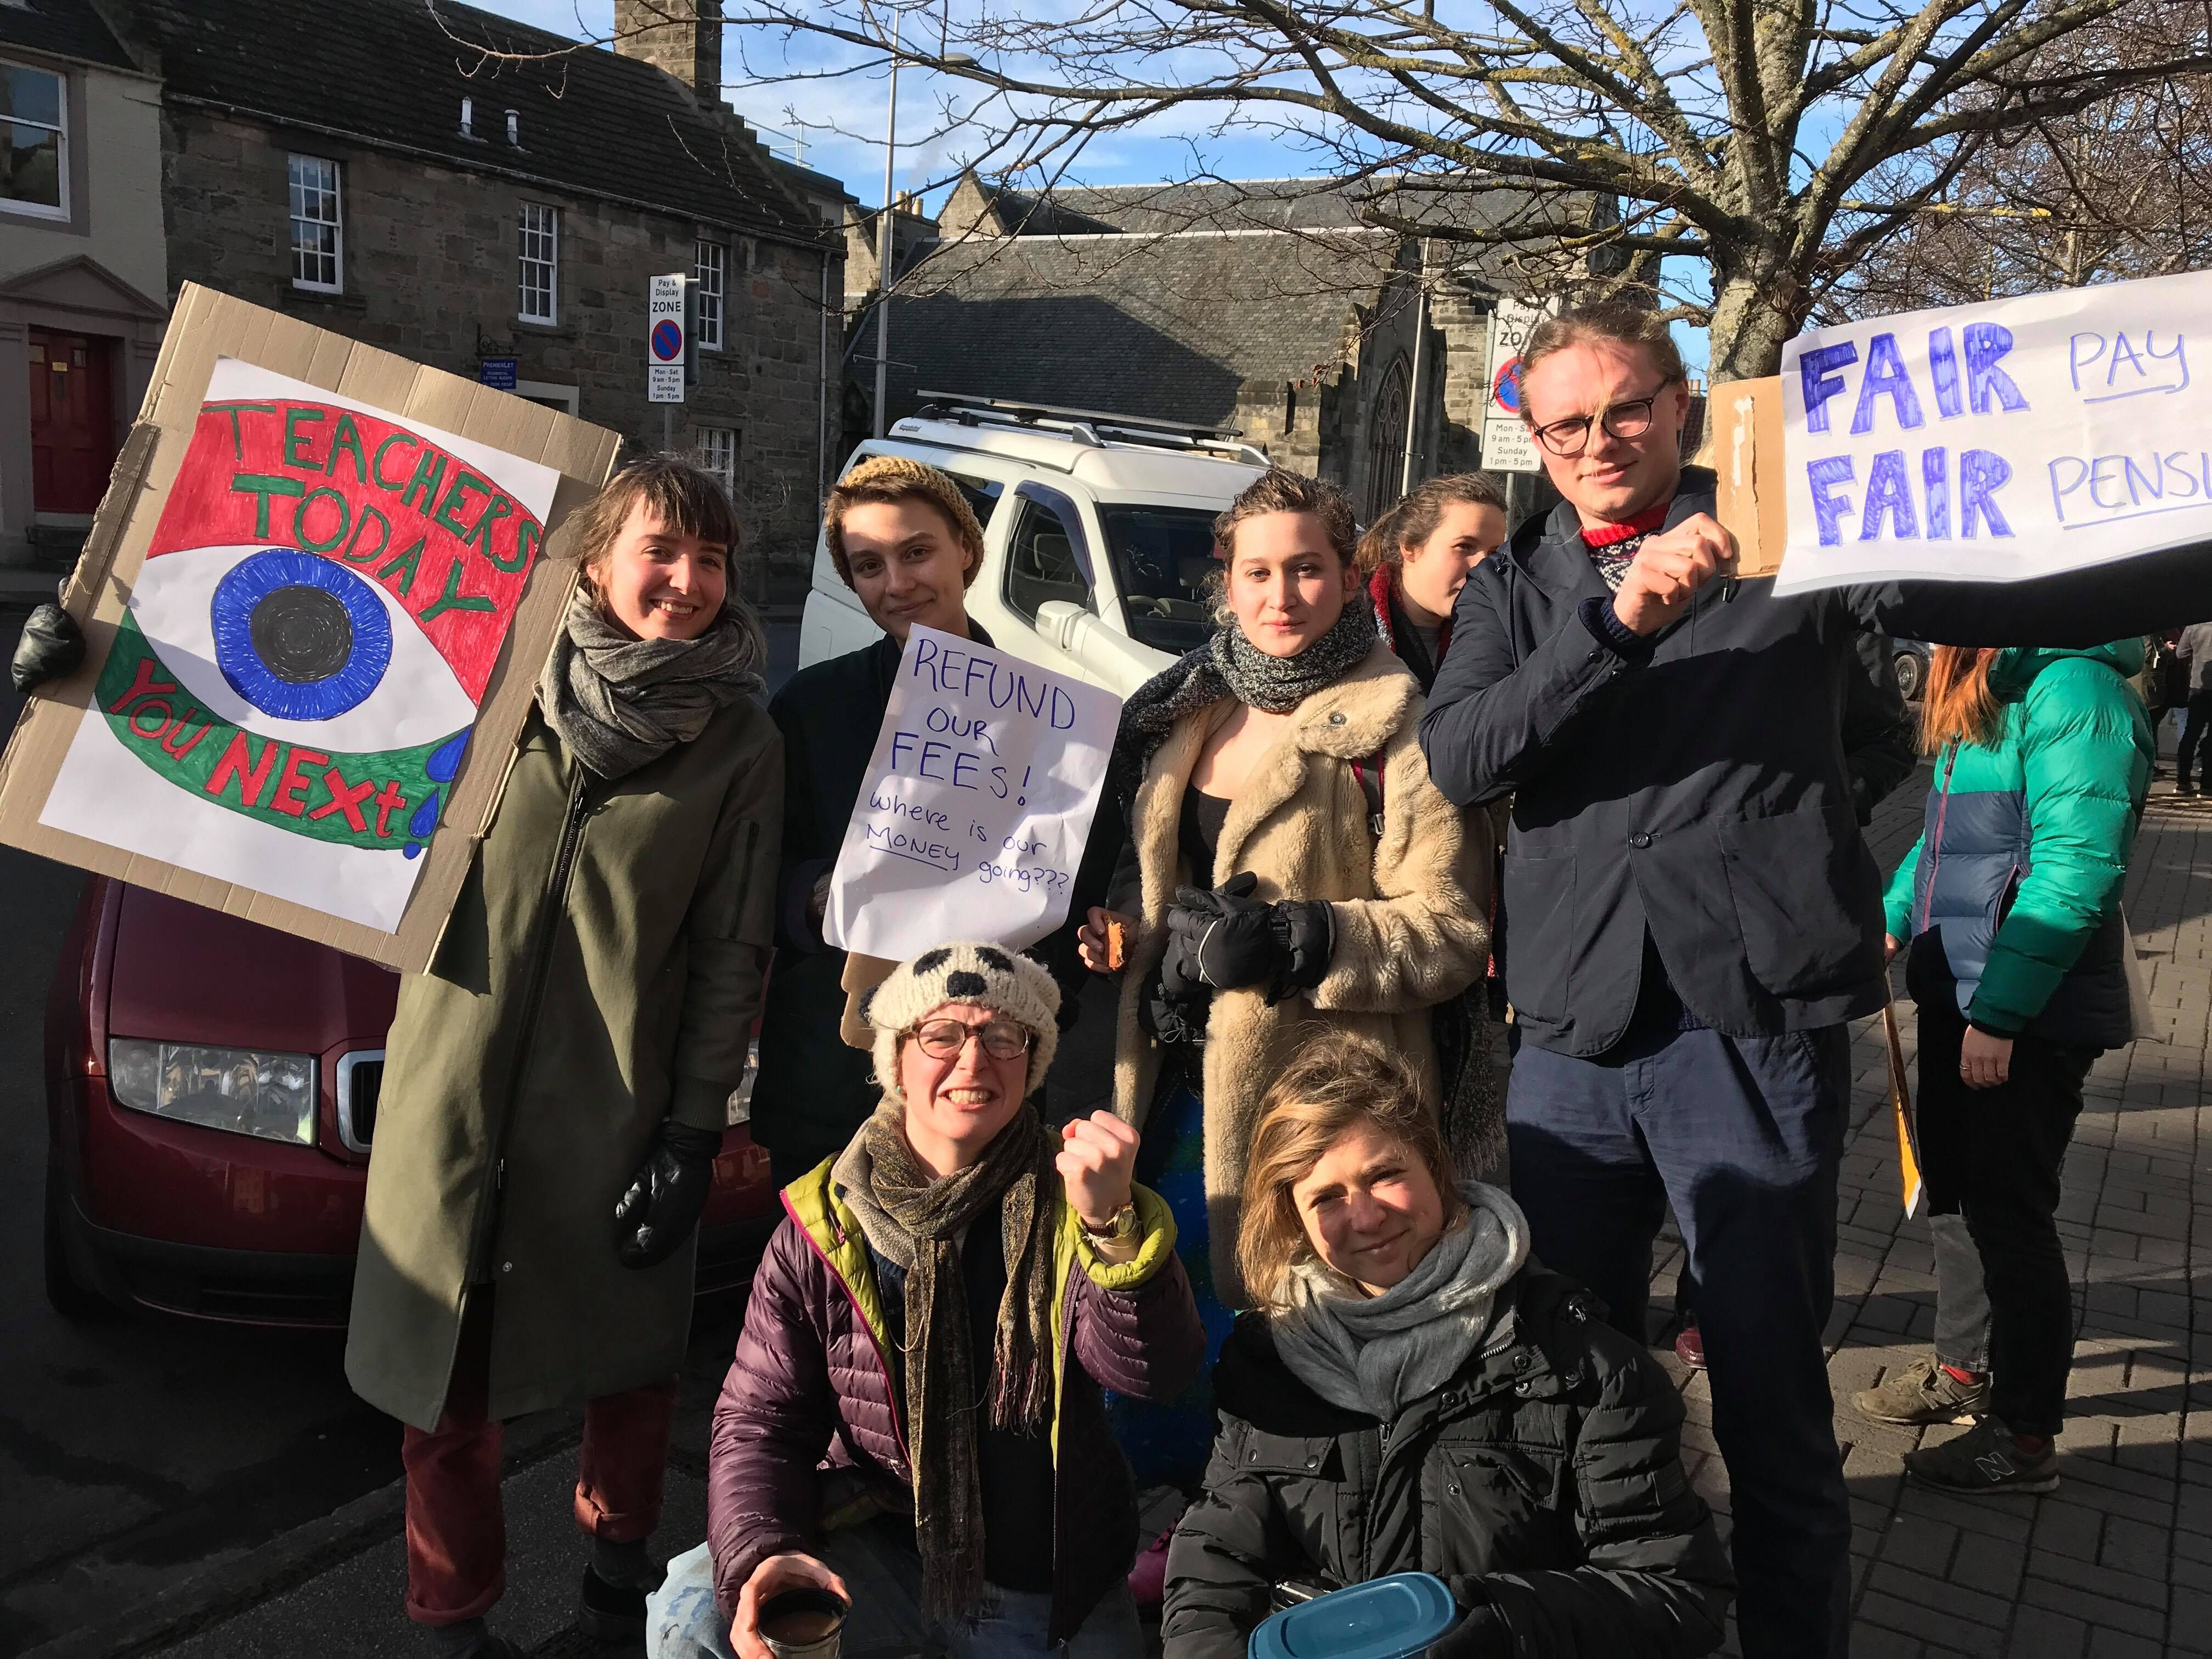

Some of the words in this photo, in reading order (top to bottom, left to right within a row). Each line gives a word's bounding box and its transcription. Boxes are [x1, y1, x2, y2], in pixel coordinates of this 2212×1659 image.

[652, 301, 681, 313] ZONE
[656, 289, 679, 297] Display
[658, 279, 670, 287] Pay
[1799, 321, 2031, 437] FAIR
[2069, 329, 2190, 395] PAY
[1497, 446, 1528, 456] Sunday
[200, 405, 540, 573] TEACHERS
[1807, 446, 2016, 548] FAIR
[230, 473, 498, 623] TODAY
[913, 639, 1076, 729] REFUND
[926, 707, 999, 757] OUR
[891, 731, 1031, 806] FEES!
[869, 791, 951, 831] where
[969, 819, 987, 842] is
[1003, 836, 1047, 855] our
[867, 823, 960, 871] MONEY
[979, 861, 1070, 895] going???
[1975, 1452, 2015, 1481] N
